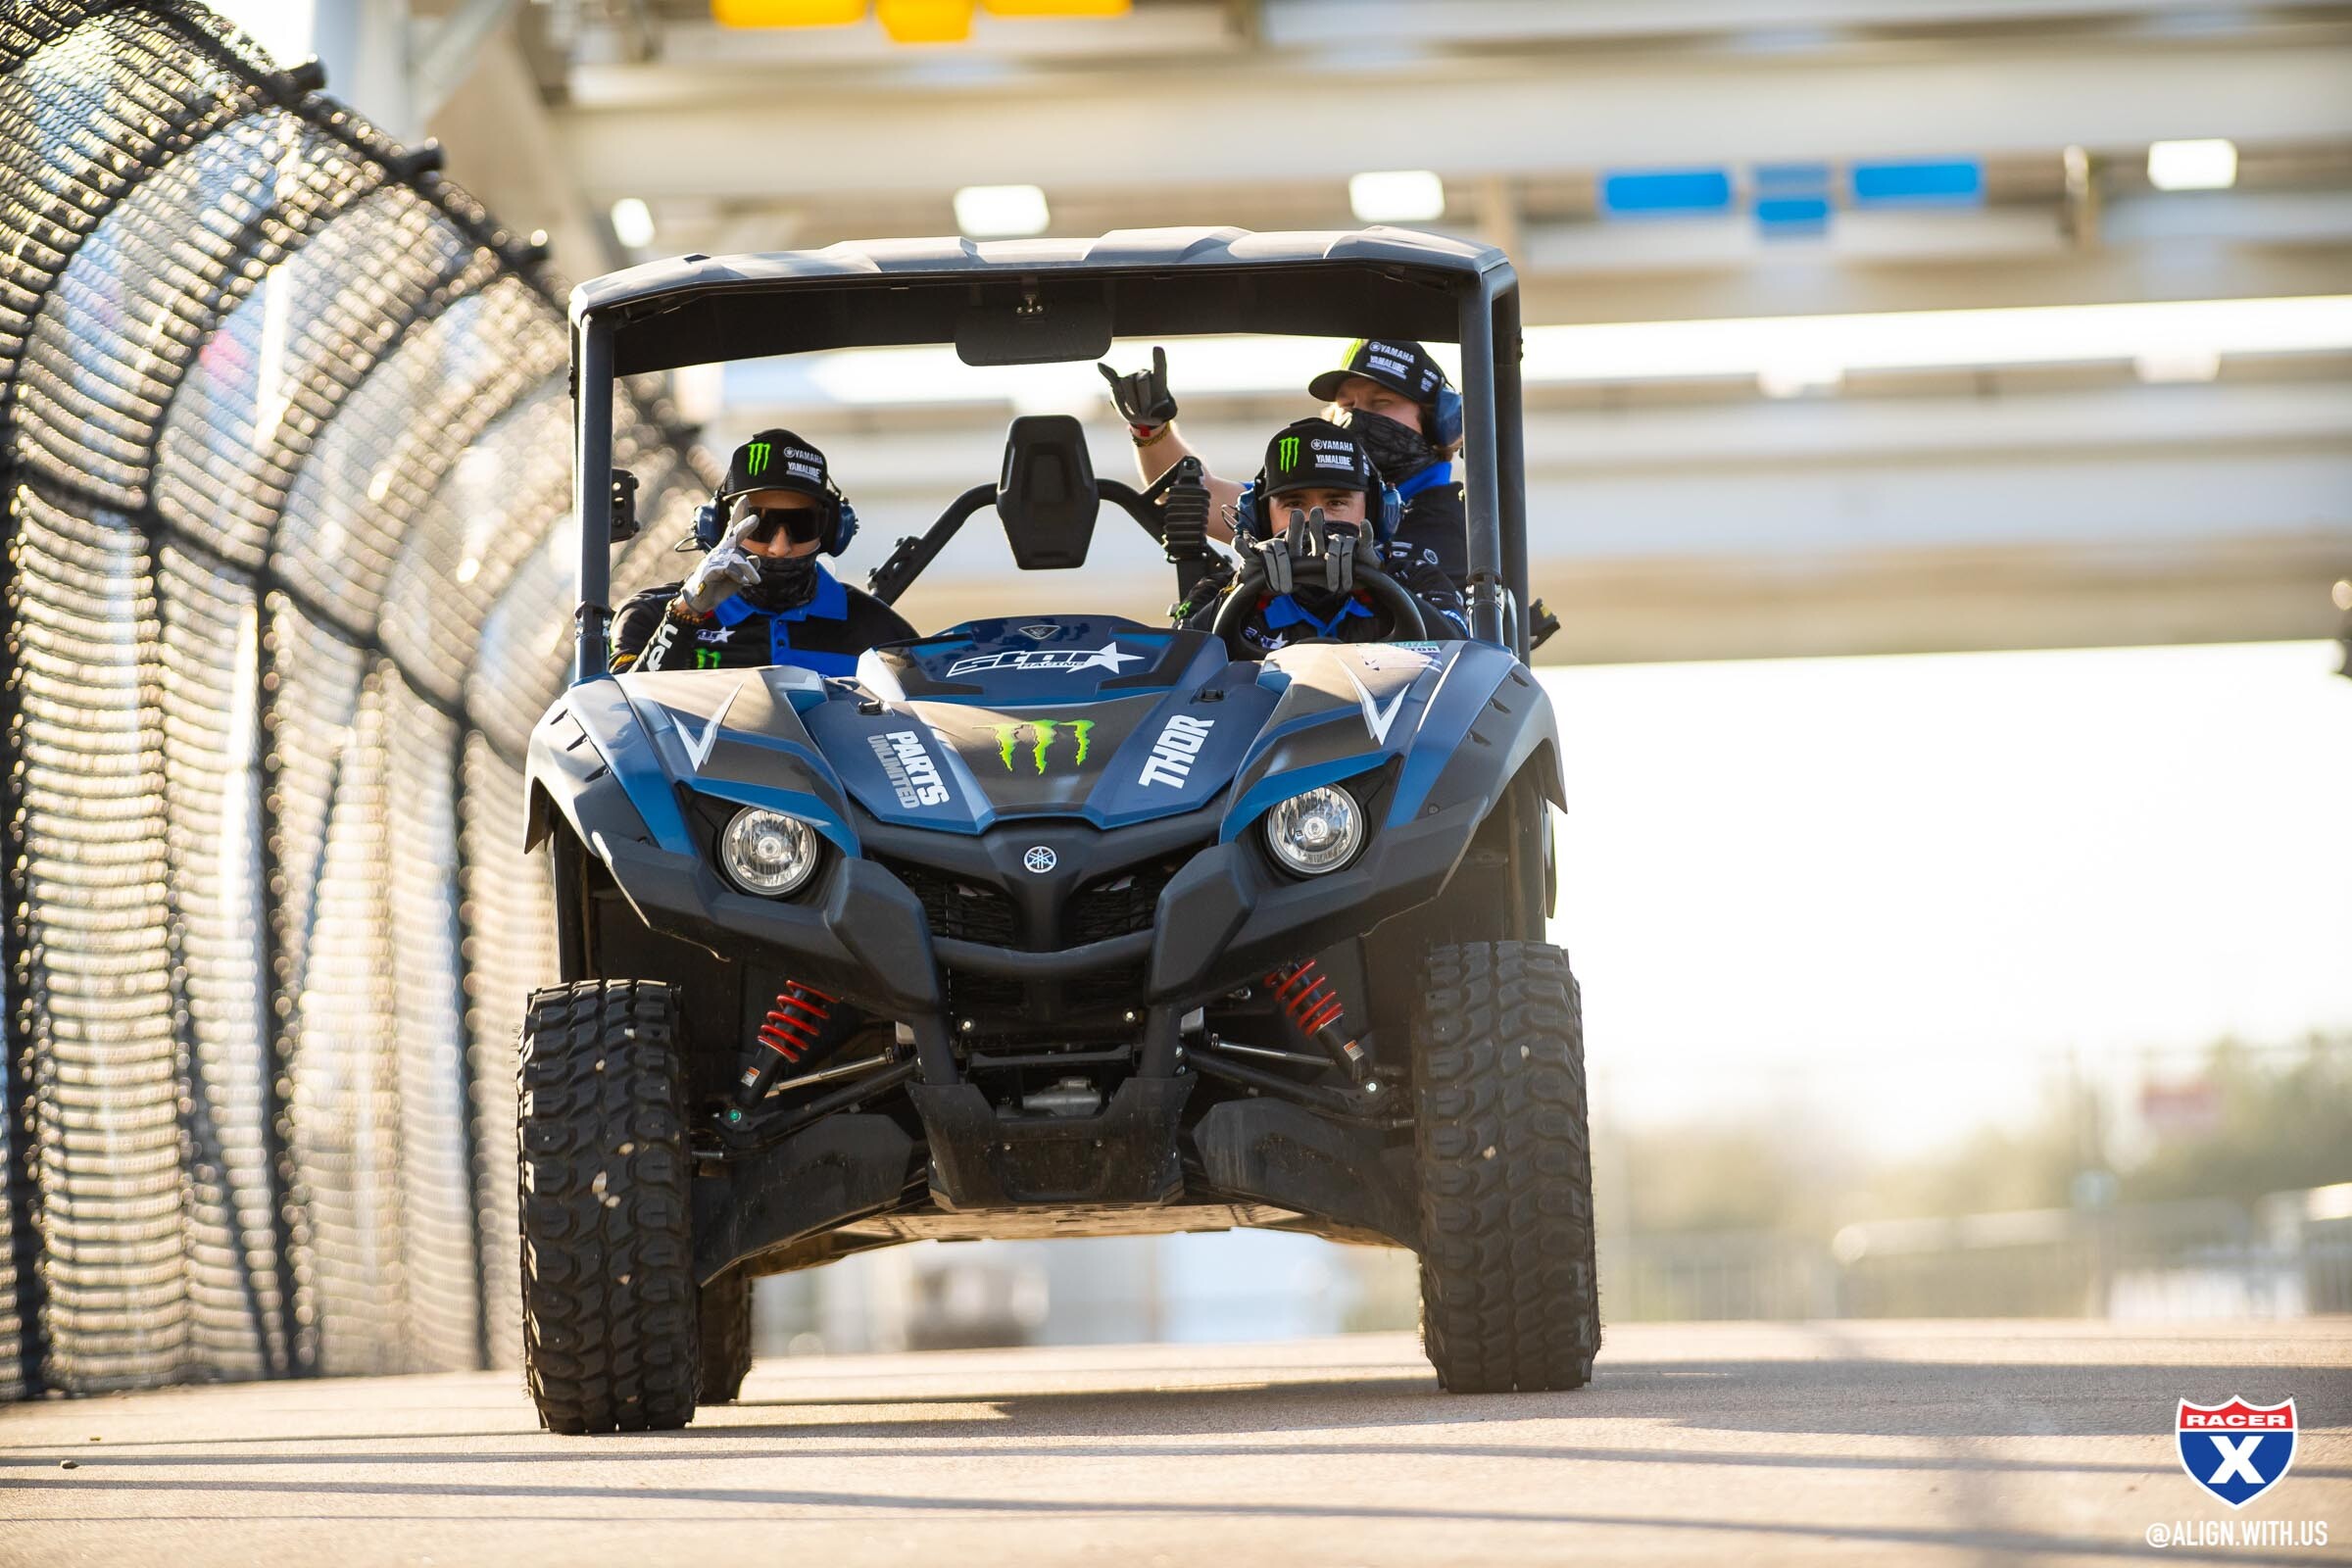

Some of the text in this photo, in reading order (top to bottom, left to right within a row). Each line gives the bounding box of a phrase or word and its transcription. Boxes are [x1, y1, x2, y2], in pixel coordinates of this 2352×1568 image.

[1381, 345, 1415, 364] YAMAHA
[1370, 356, 1405, 373] YAMALUBE
[1322, 440, 1353, 452] YAMAHA
[795, 450, 823, 465] YAMAHA
[1316, 455, 1351, 466] YAMALUBE
[788, 462, 821, 478] YAMALUBE
[1139, 714, 1215, 789] THOR
[867, 735, 920, 808] UNLIMITED
[886, 731, 950, 806] PARTS
